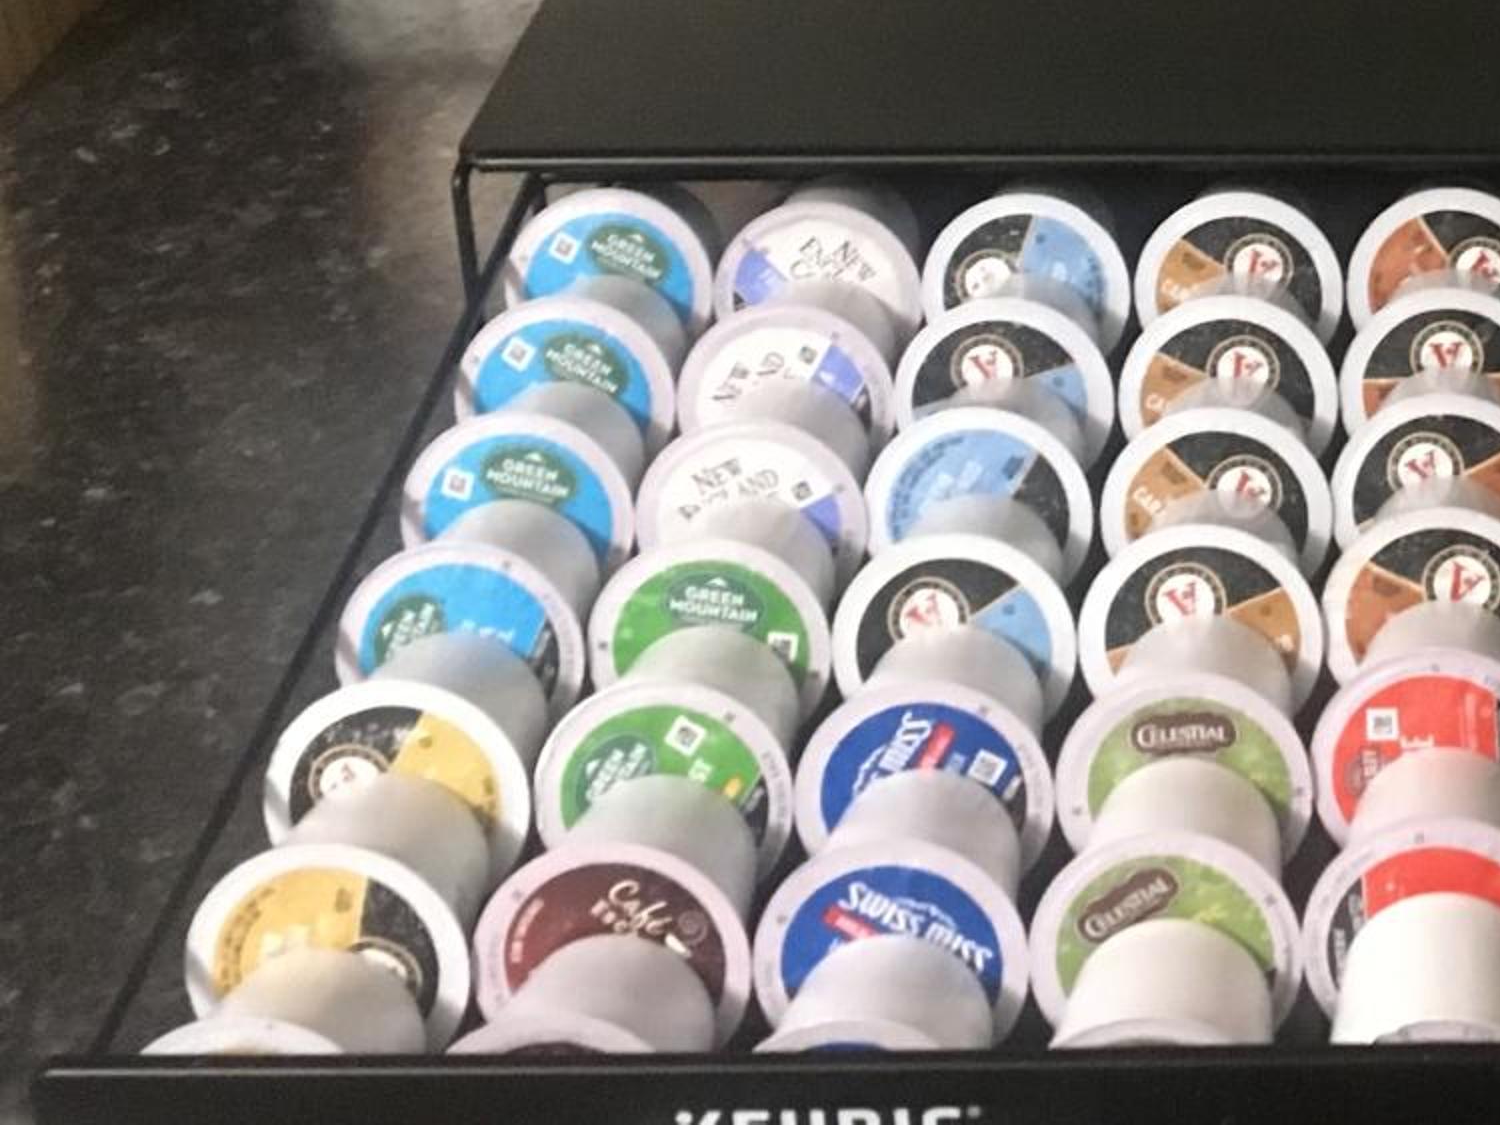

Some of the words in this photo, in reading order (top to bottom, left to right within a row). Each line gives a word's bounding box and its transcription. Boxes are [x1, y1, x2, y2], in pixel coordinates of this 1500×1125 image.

[591, 240, 663, 278] MOUNTAIN
[607, 233, 655, 262] GREEN
[545, 349, 619, 393] MOUNTAIN
[564, 342, 612, 375] GREEN
[486, 468, 570, 498] MOUNTAIN
[502, 458, 559, 481] GREEN
[668, 597, 759, 622] MOUNTAIN
[684, 585, 744, 605] GREEN
[1136, 724, 1228, 748] CELESTIAL
[1083, 876, 1171, 938] CELESTIAL
